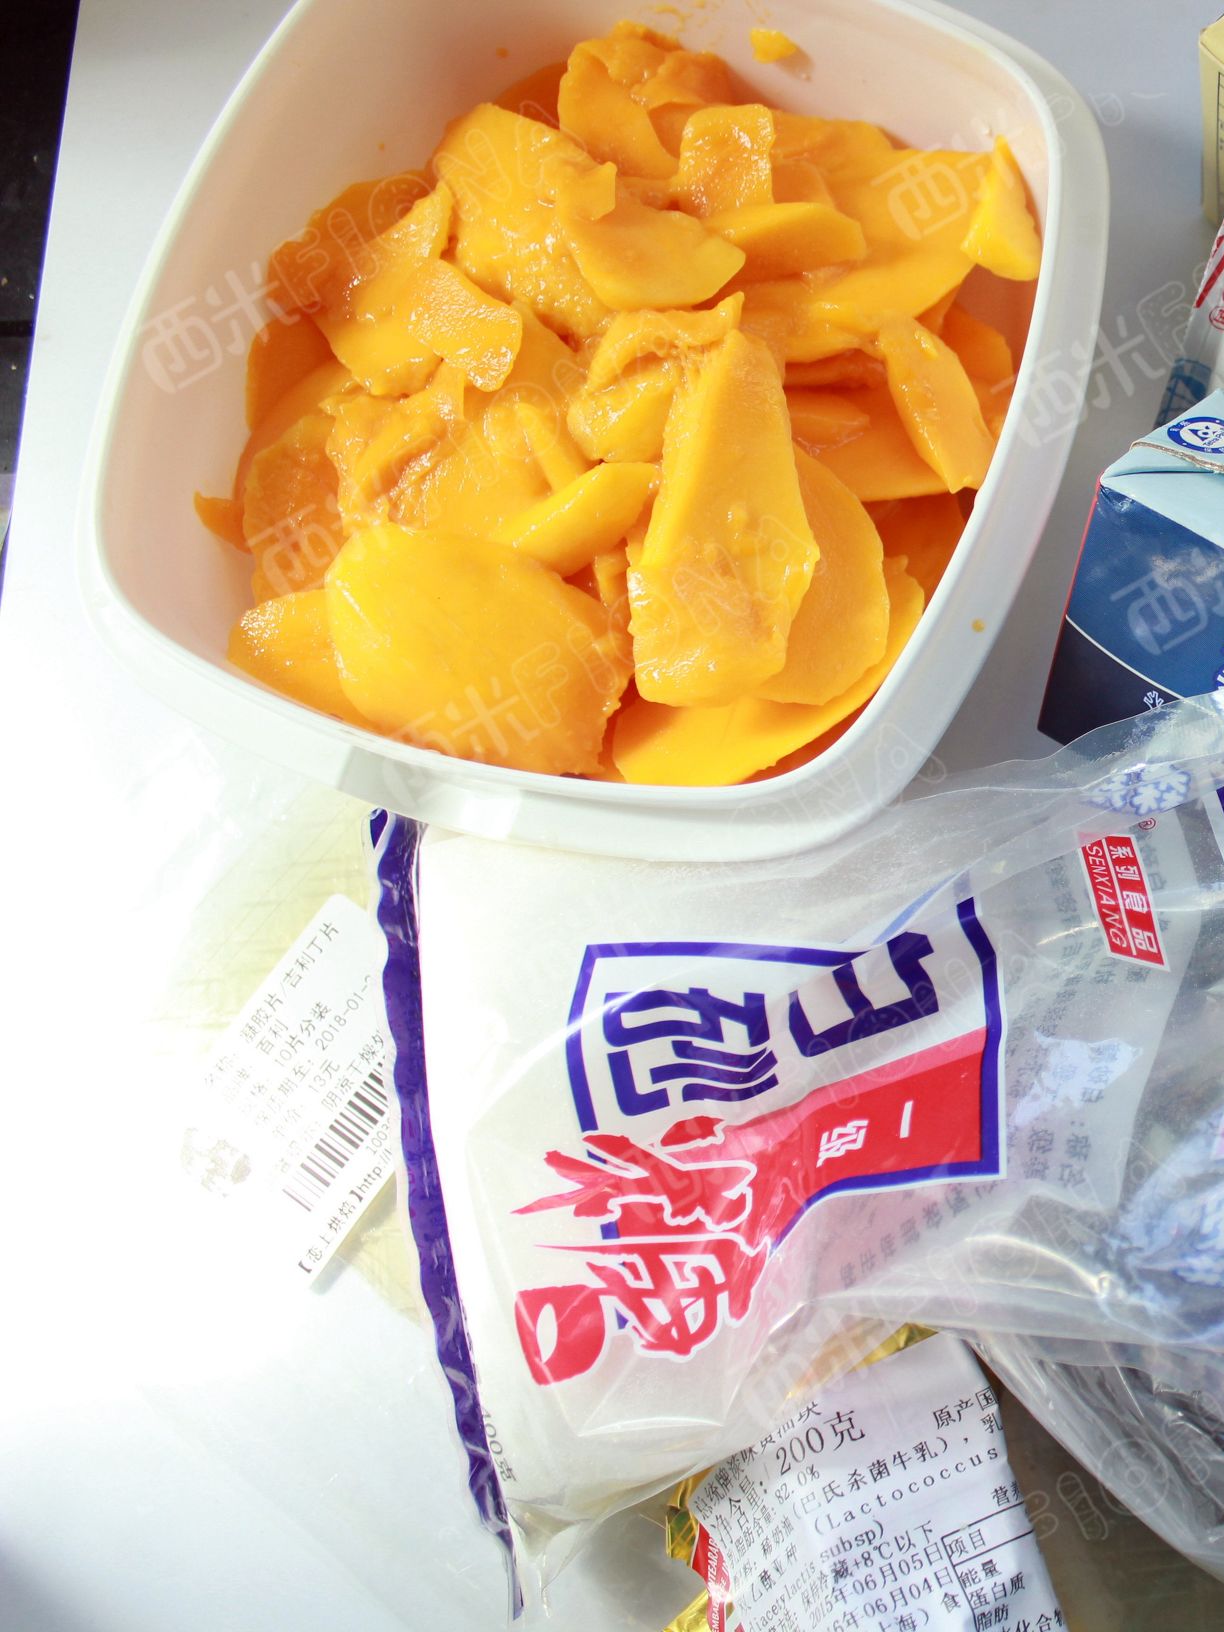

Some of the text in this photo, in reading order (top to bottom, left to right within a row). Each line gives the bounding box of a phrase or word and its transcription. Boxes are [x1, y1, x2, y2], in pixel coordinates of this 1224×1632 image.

[1085, 842, 1127, 950] SENXIANG
[1108, 842, 1158, 956] 系列食品
[254, 1017, 290, 1057] 百利
[272, 998, 332, 1070] 10片分装
[816, 1101, 913, 1167] 一级
[932, 1386, 1000, 1429] 原产国
[776, 1408, 866, 1476] 200克
[947, 1529, 987, 1558] 项目
[959, 1559, 1003, 1588] 能量
[969, 1572, 1025, 1610] 蛋白质
[977, 1605, 1009, 1630] 脂肪
